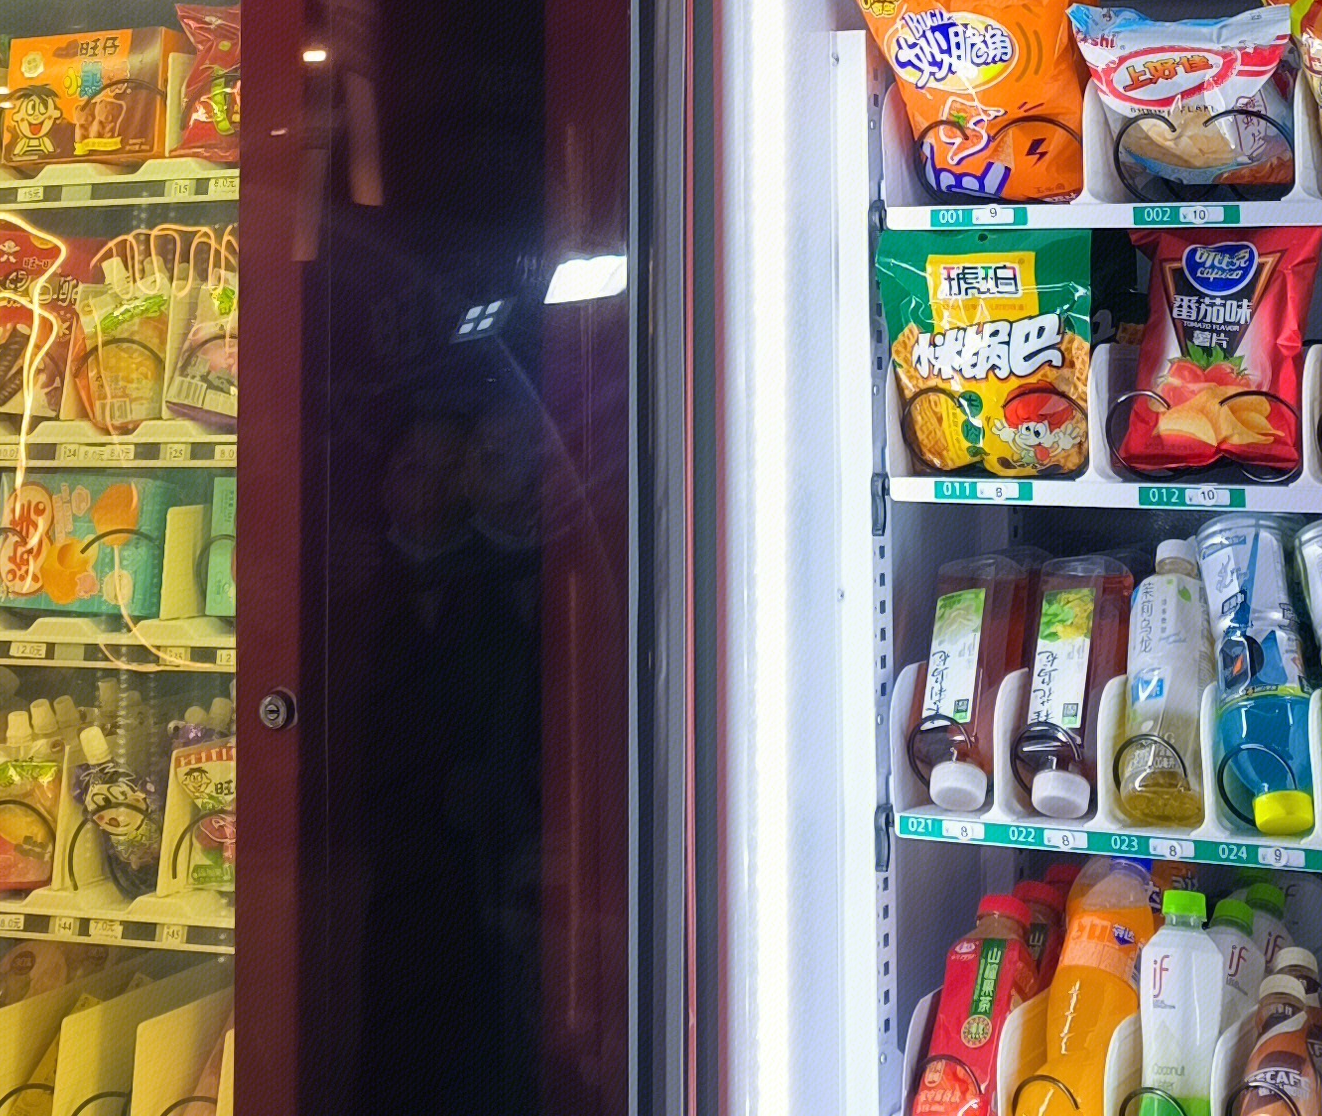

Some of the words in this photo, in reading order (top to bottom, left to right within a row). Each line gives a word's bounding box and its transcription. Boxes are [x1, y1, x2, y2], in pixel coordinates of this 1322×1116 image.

[79, 36, 120, 57] 旺仔
[895, 23, 1014, 89] 妙脆角
[1123, 54, 1214, 92] 上好佳
[939, 210, 963, 223] 001
[989, 208, 998, 218] 9
[1144, 208, 1171, 222] 002
[1192, 209, 1207, 220] 10
[1172, 294, 1254, 324] 番茄味
[1183, 320, 1211, 330] TOMATO
[1212, 324, 1240, 332] FLAVOR
[1193, 330, 1229, 349] 薯片
[943, 482, 971, 495] 011
[1149, 488, 1179, 502] 012
[1201, 489, 1215, 500] 10
[908, 819, 933, 832] 021
[961, 826, 969, 837] 8
[1009, 827, 1035, 842] 022
[1062, 835, 1070, 846] 8
[1111, 836, 1139, 851] 023
[1169, 845, 1177, 856] 8
[1218, 845, 1247, 861] 024
[1274, 847, 1282, 860] 9
[1228, 944, 1248, 977] if
[1152, 954, 1171, 999] if
[1152, 1065, 1185, 1077] Coconut
